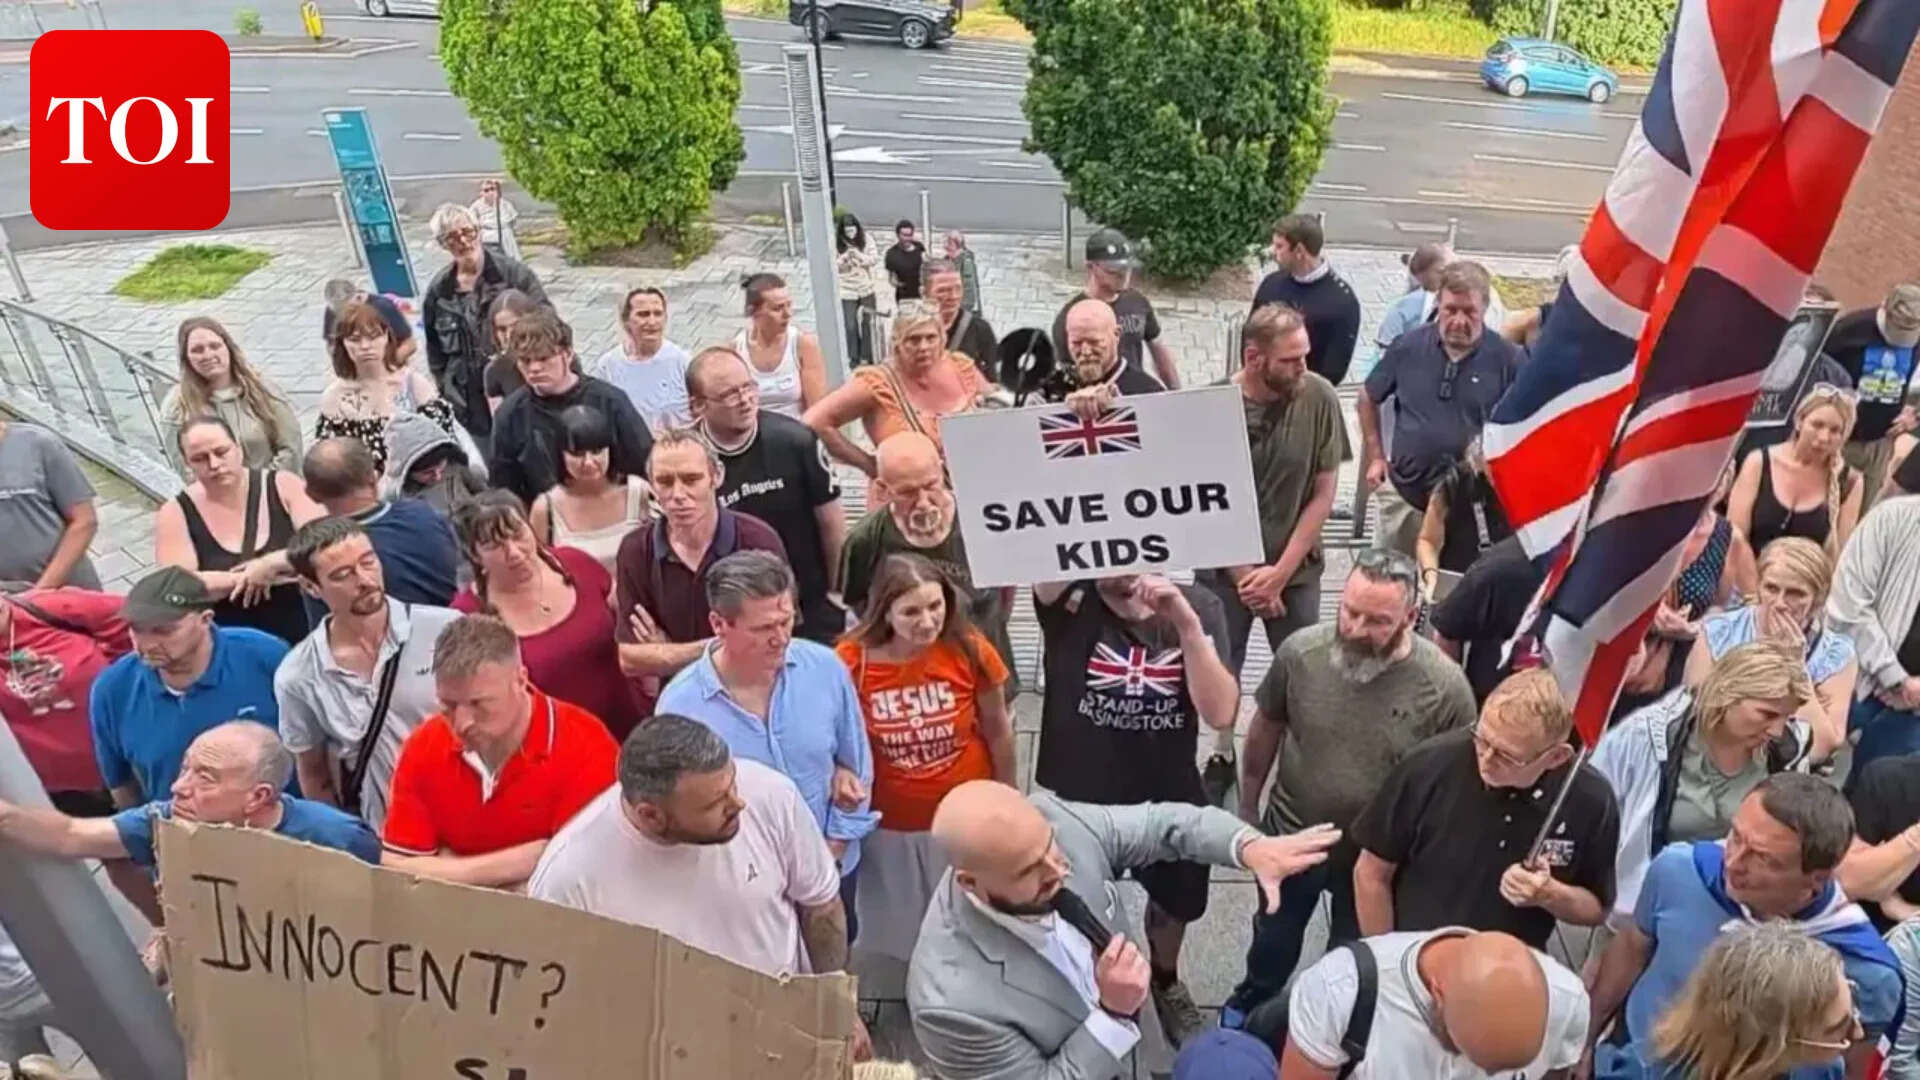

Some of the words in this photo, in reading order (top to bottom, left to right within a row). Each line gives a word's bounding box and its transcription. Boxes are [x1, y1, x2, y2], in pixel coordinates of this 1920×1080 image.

[718, 490, 740, 508] Los
[741, 478, 784, 497] Angeles
[982, 493, 1109, 533] SAVE
[1124, 482, 1230, 519] OUR
[1056, 534, 1170, 571] KIDS
[870, 681, 957, 721] JESUS
[1086, 690, 1178, 713] STAND-UP
[880, 731, 912, 744] THE
[915, 722, 955, 741] WAY
[191, 873, 567, 1030] INNOCENT?
